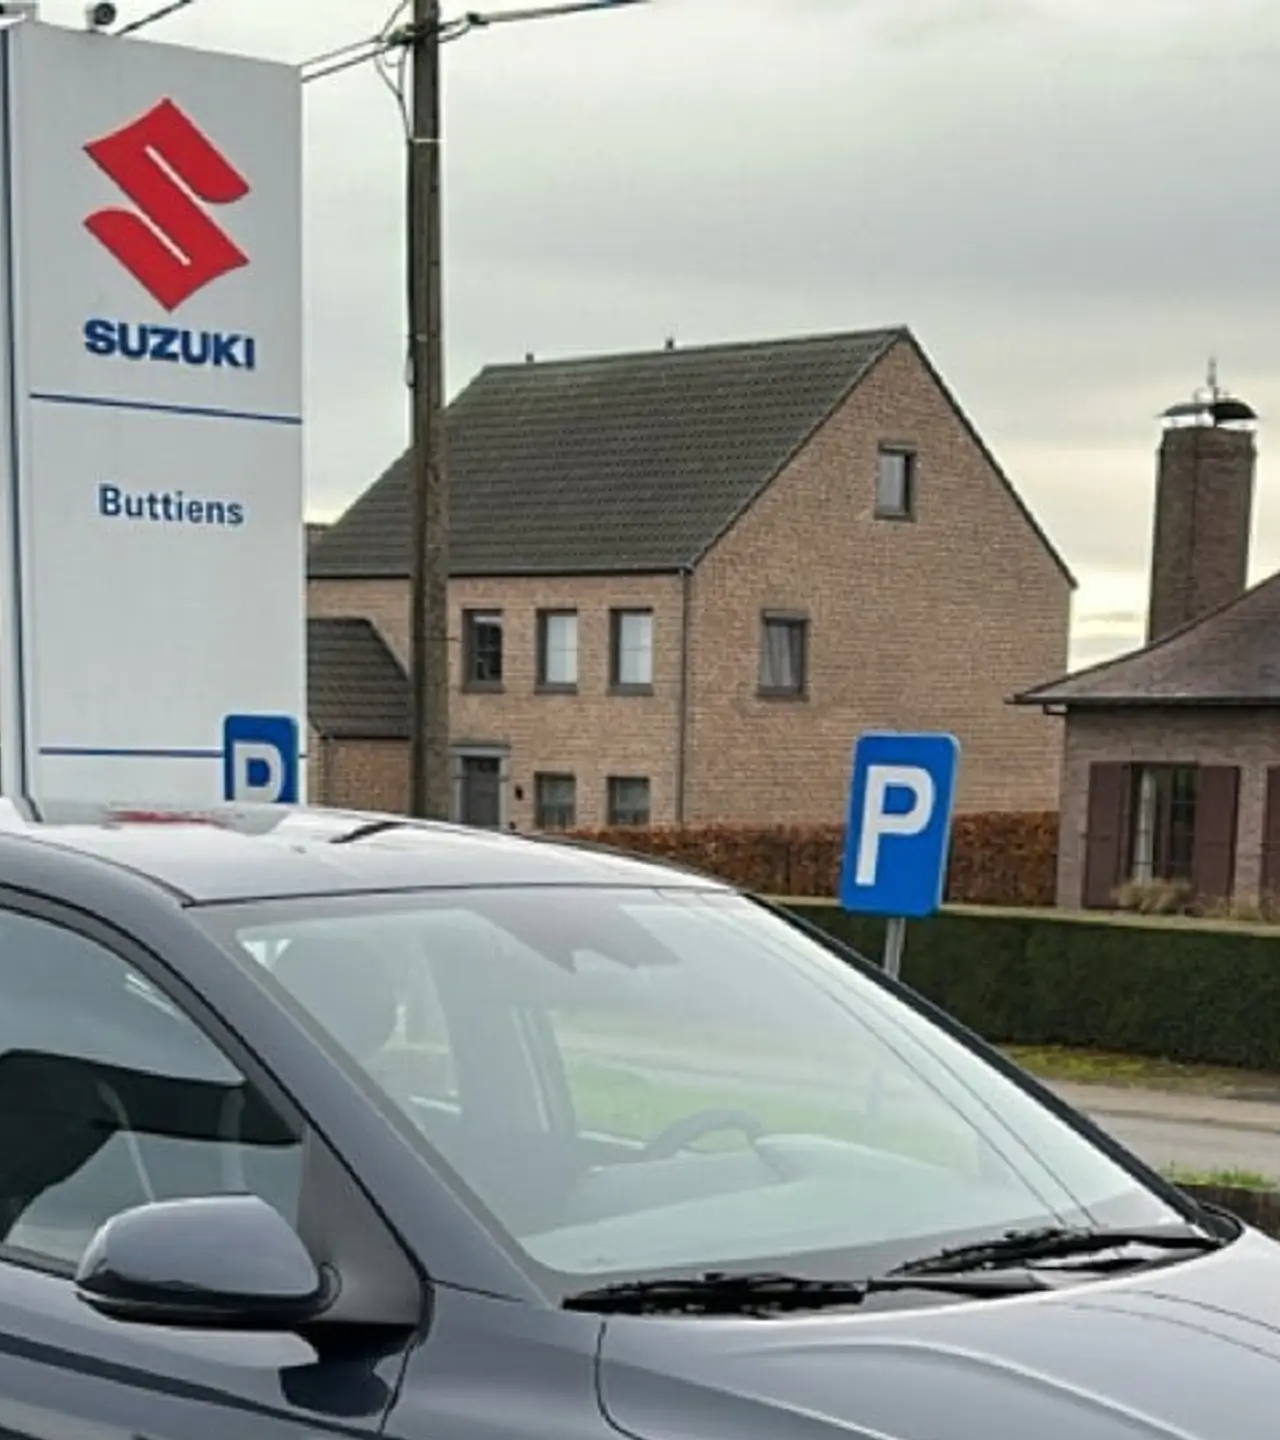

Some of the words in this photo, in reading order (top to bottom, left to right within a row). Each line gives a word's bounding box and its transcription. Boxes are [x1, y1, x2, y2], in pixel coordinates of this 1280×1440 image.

[84, 318, 256, 371] SUZUKI
[98, 482, 244, 526] Buttiens
[855, 765, 936, 886] P
